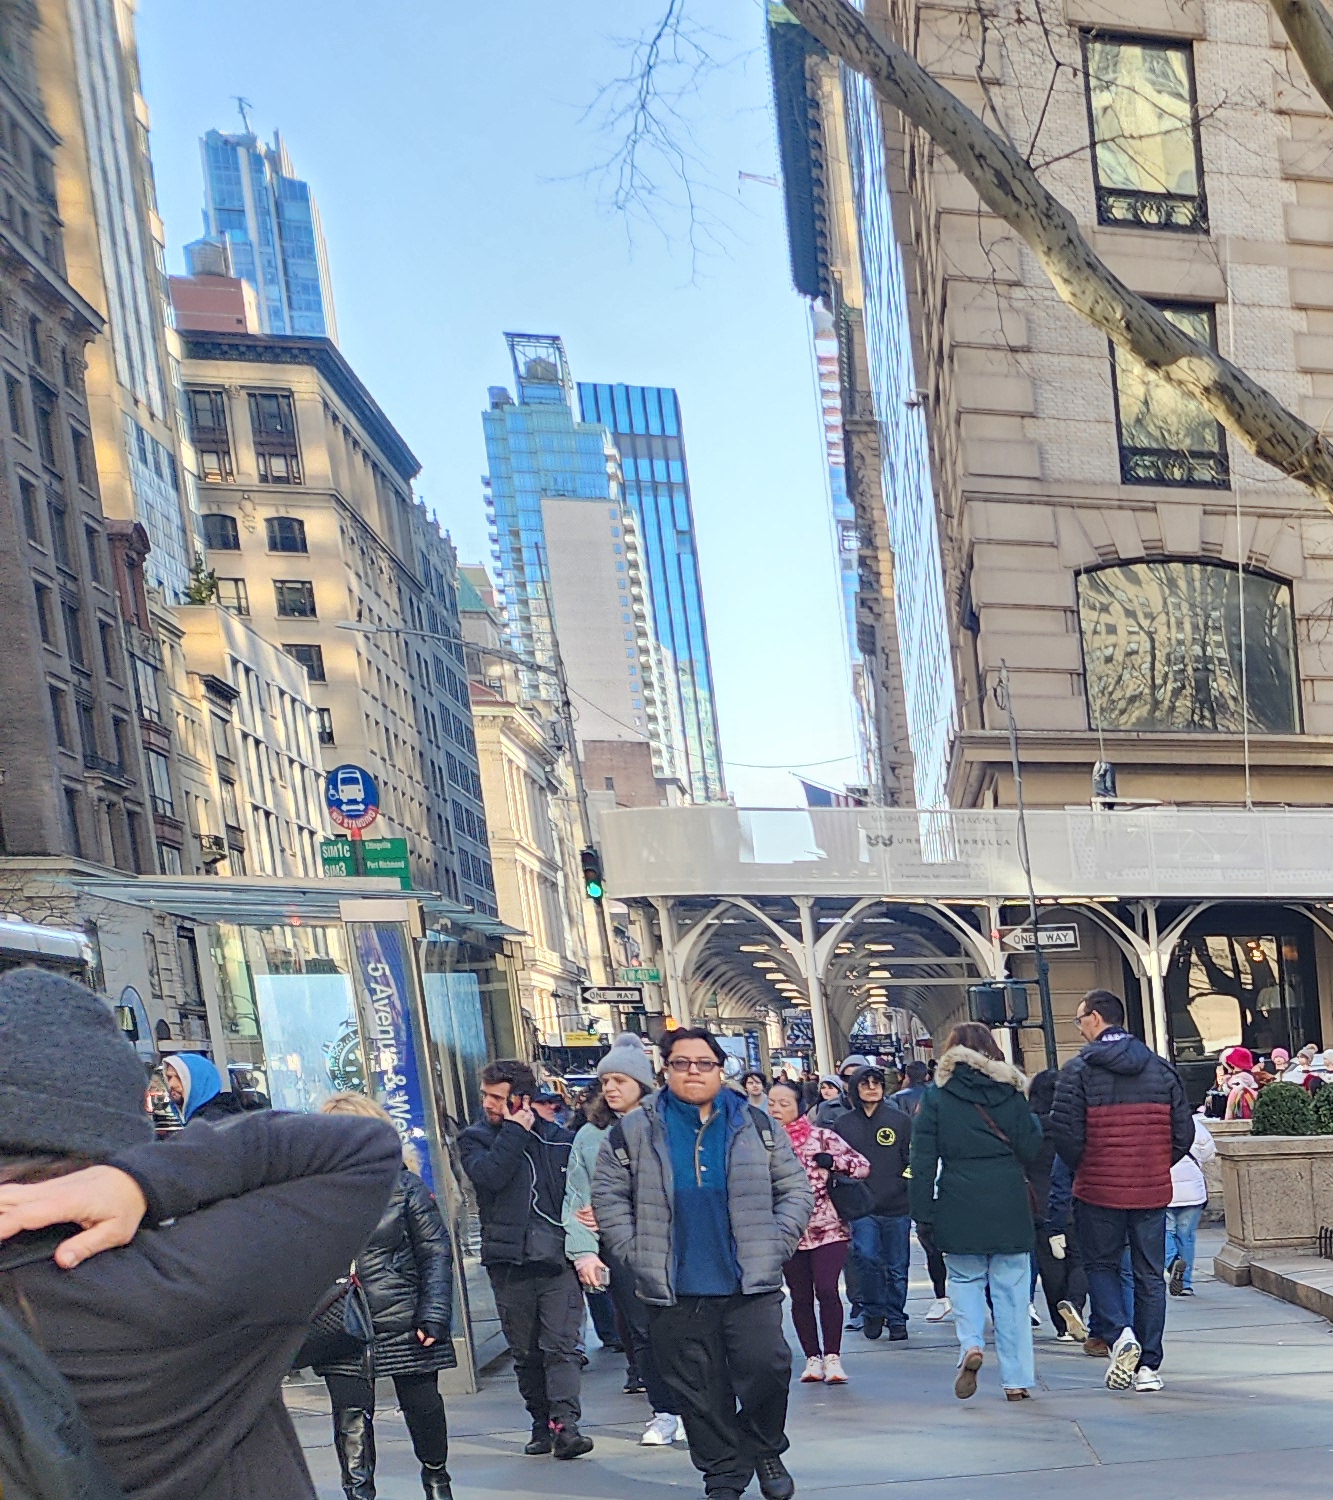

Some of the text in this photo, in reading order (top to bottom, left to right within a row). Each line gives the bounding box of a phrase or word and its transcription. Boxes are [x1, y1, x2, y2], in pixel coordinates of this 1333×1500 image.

[325, 862, 346, 877] SIM3
[1013, 933, 1068, 944] ONE WAY
[589, 990, 635, 1000] ONE WAY
[367, 962, 391, 977] 5
[386, 1094, 412, 1145] Wes
